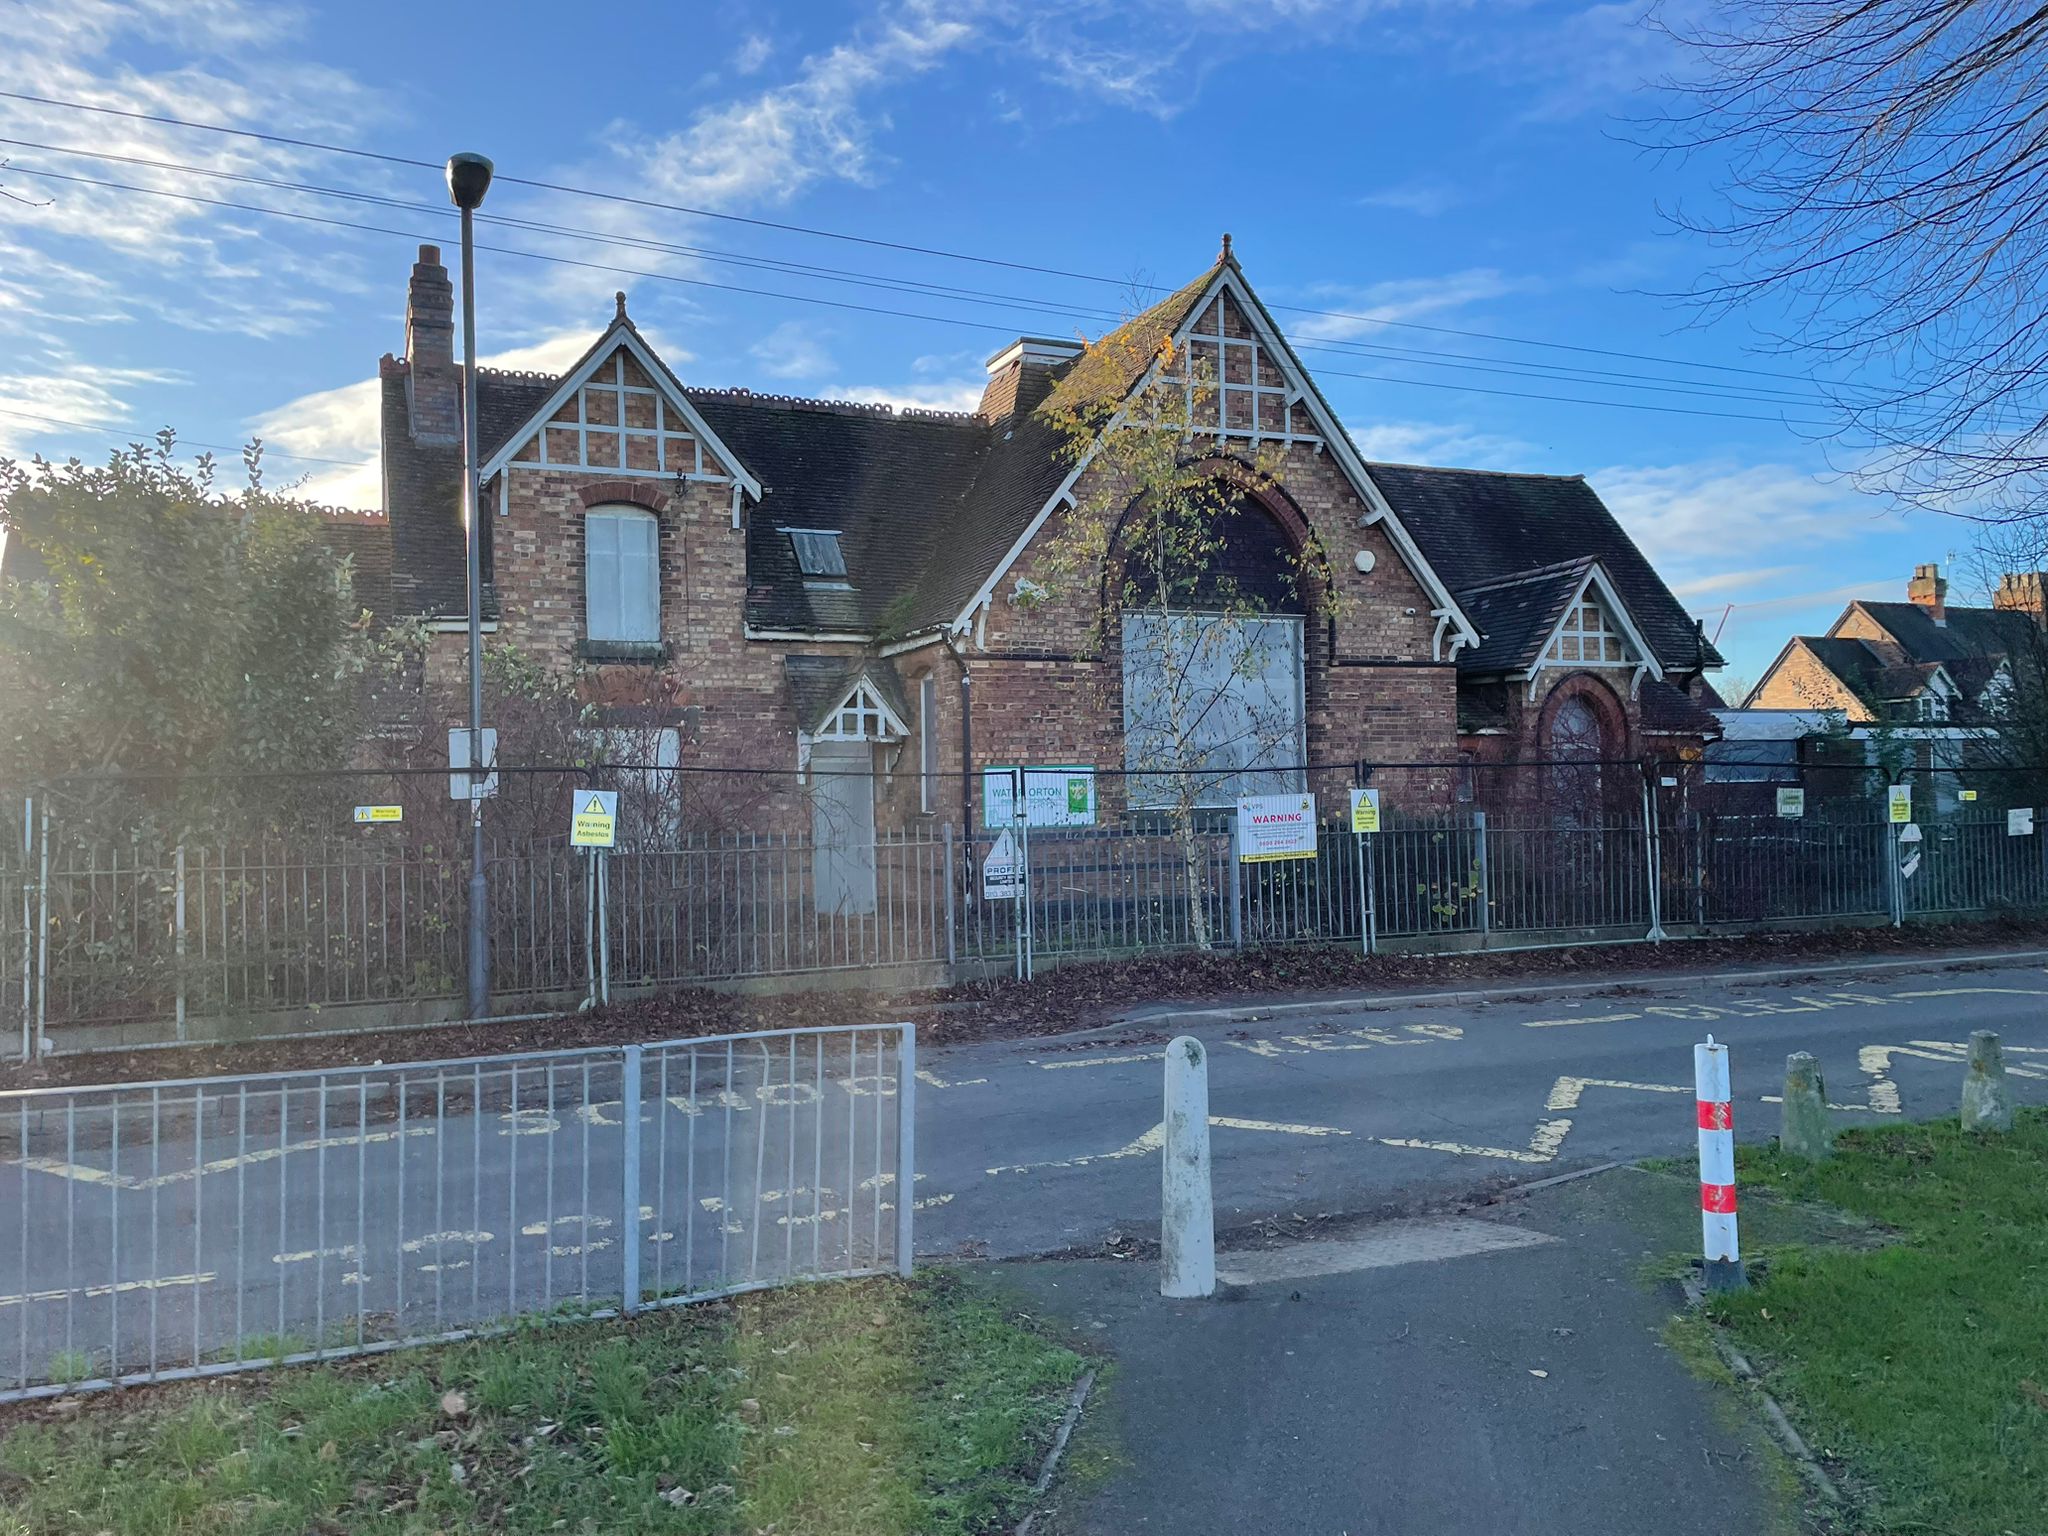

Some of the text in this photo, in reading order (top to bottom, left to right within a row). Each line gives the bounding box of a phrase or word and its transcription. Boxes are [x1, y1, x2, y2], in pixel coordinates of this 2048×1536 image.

[992, 788, 1023, 797] WAT
[1028, 787, 1062, 797] ORTON
[577, 820, 610, 829] Waning
[1252, 813, 1302, 824] WARNING
[1645, 993, 1913, 1020] CLEAR
[1222, 1023, 1465, 1057] KEEP
[497, 1070, 989, 1137] SCHOOL
